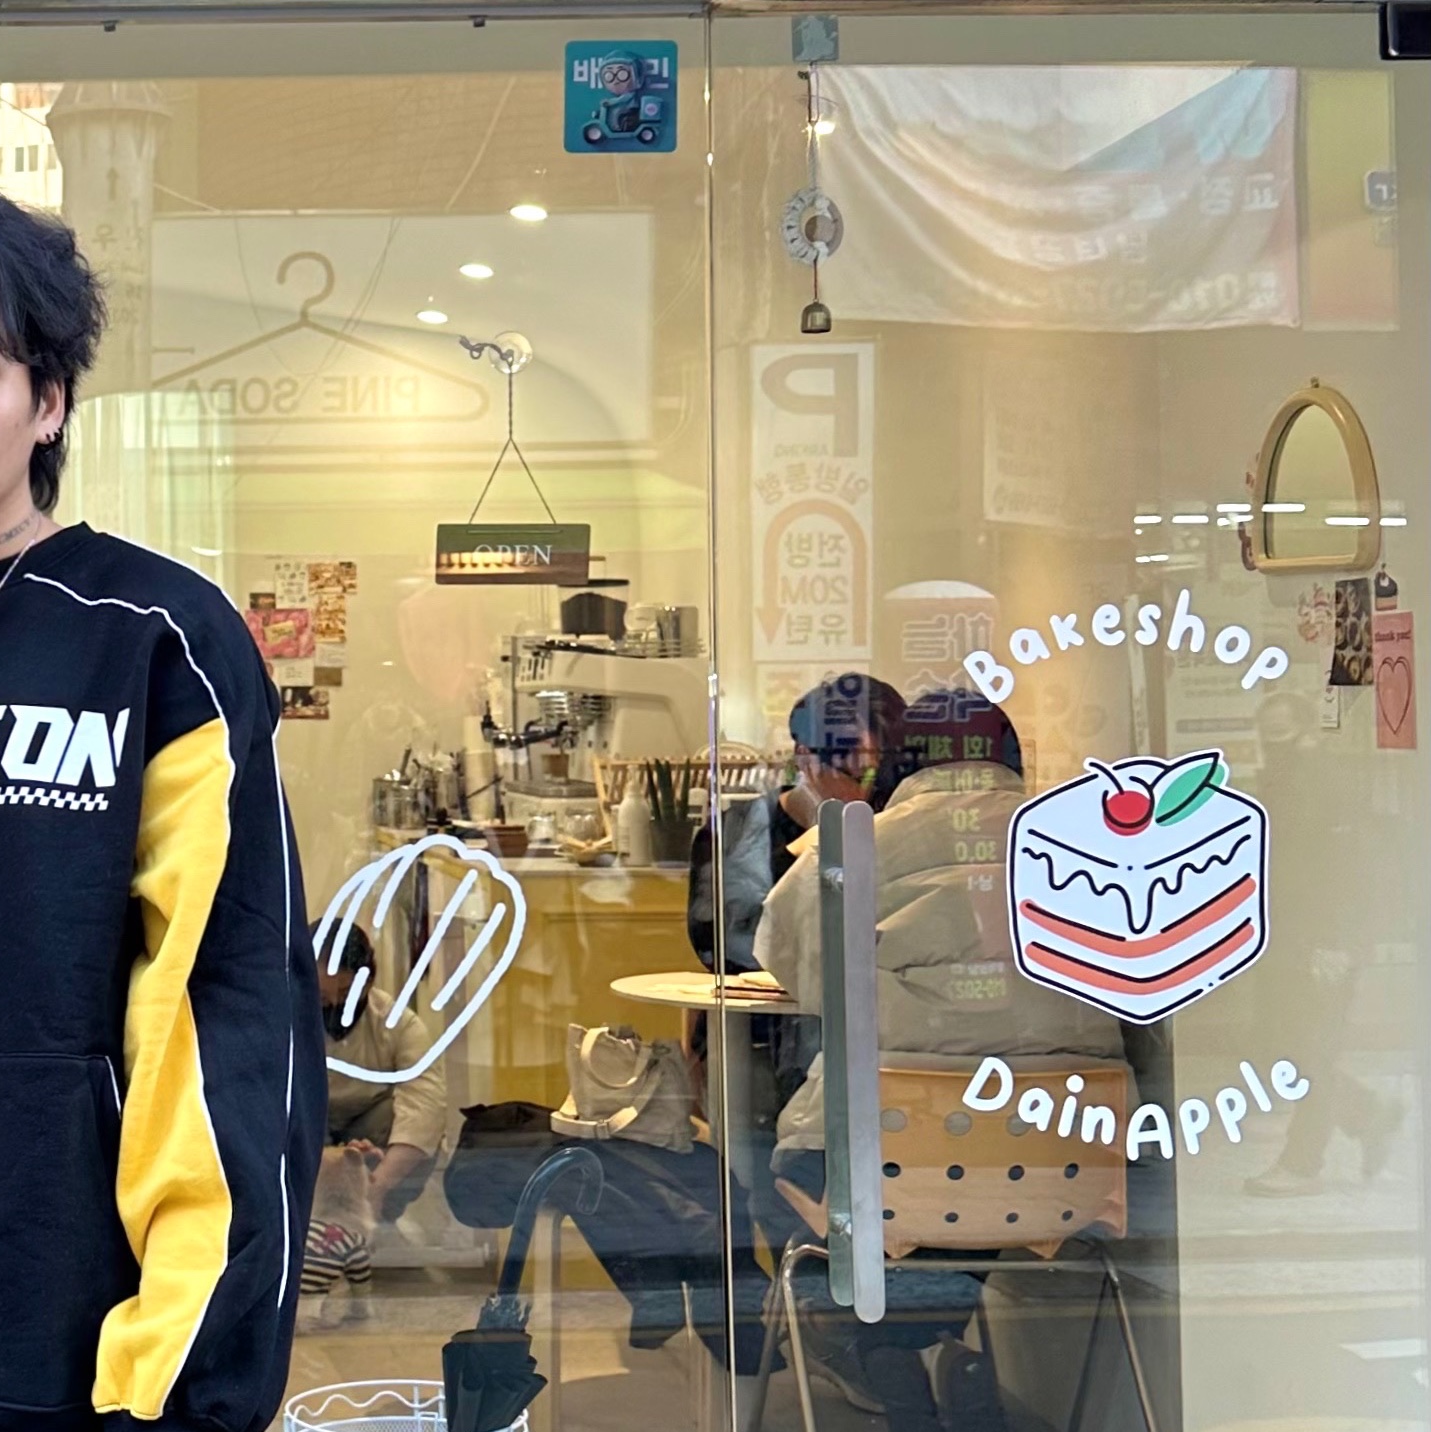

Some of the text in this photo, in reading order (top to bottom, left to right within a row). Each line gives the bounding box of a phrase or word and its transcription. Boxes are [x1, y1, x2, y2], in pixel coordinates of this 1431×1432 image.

[474, 544, 552, 566] OPEN
[963, 587, 1289, 703] Bakeshop
[961, 1055, 1311, 1162] DainApple
